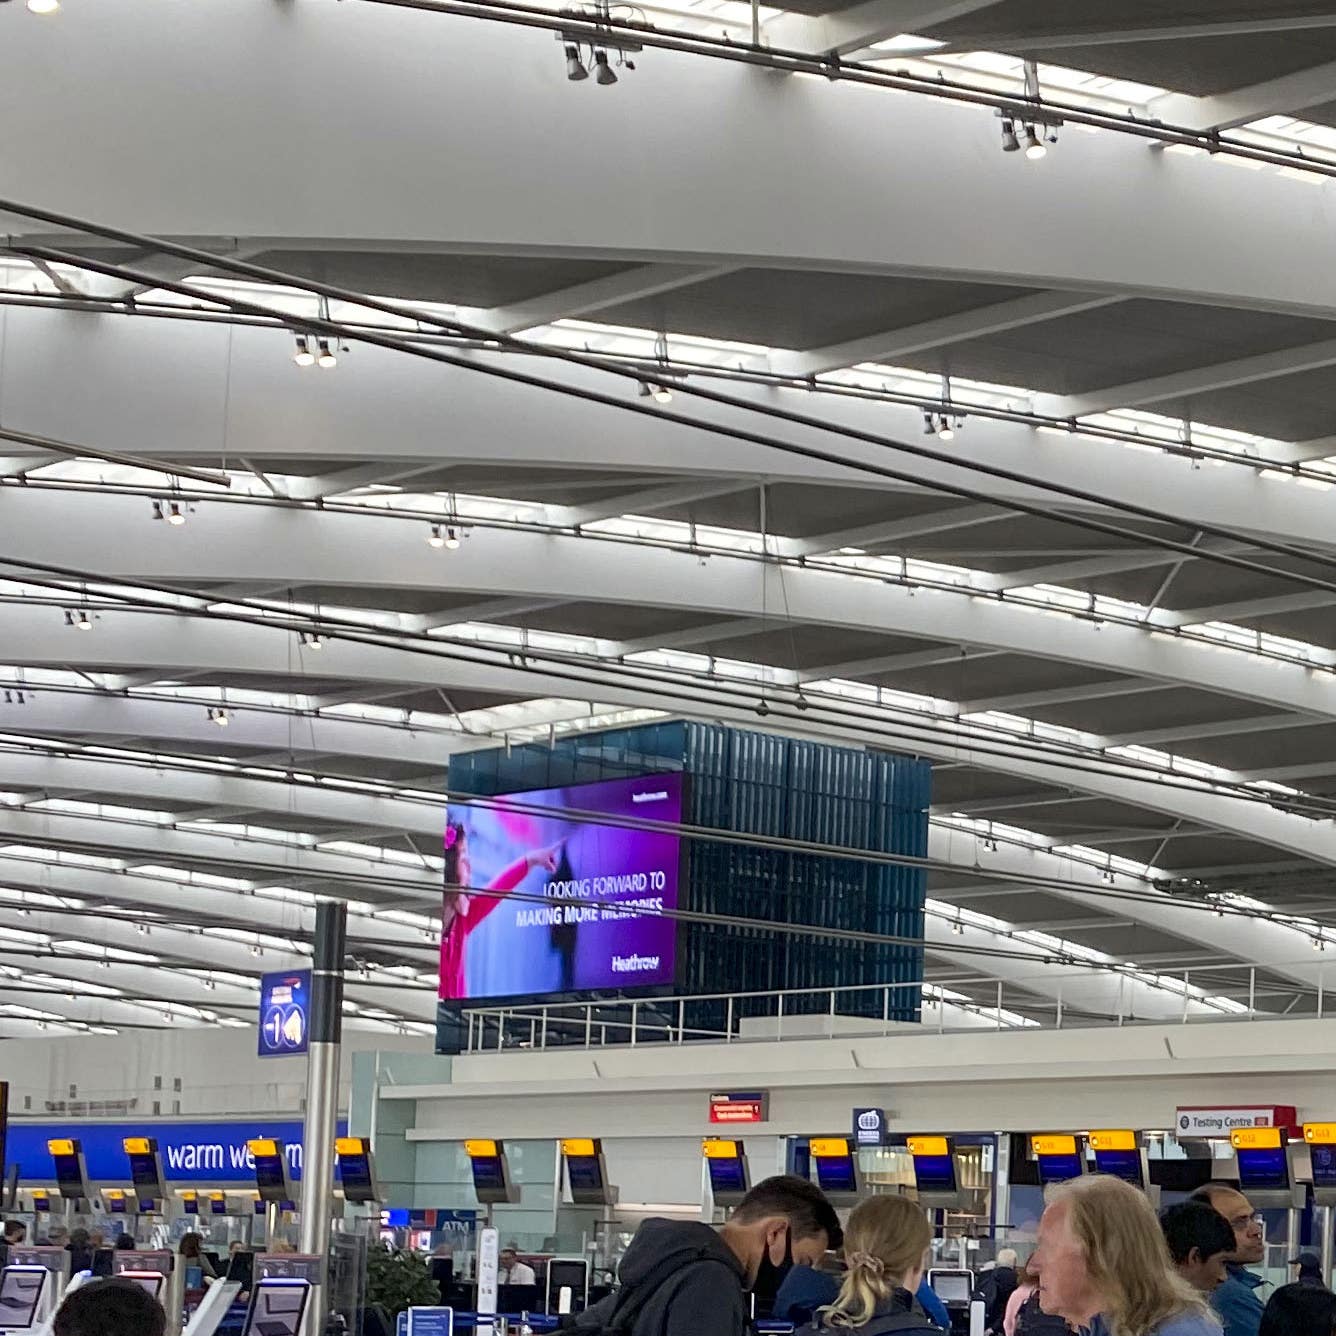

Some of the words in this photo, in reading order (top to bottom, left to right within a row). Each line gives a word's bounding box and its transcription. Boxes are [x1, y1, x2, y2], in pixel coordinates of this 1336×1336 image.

[543, 879, 590, 899] LOOKING
[592, 873, 647, 896] FORWARD
[650, 870, 666, 891] TO
[516, 906, 562, 927] MAKING
[612, 953, 660, 972] Heathrow
[1193, 1116, 1223, 1129] Testing
[1224, 1115, 1252, 1127] Centre
[167, 1143, 223, 1169] warm
[442, 1220, 470, 1233] ATM
